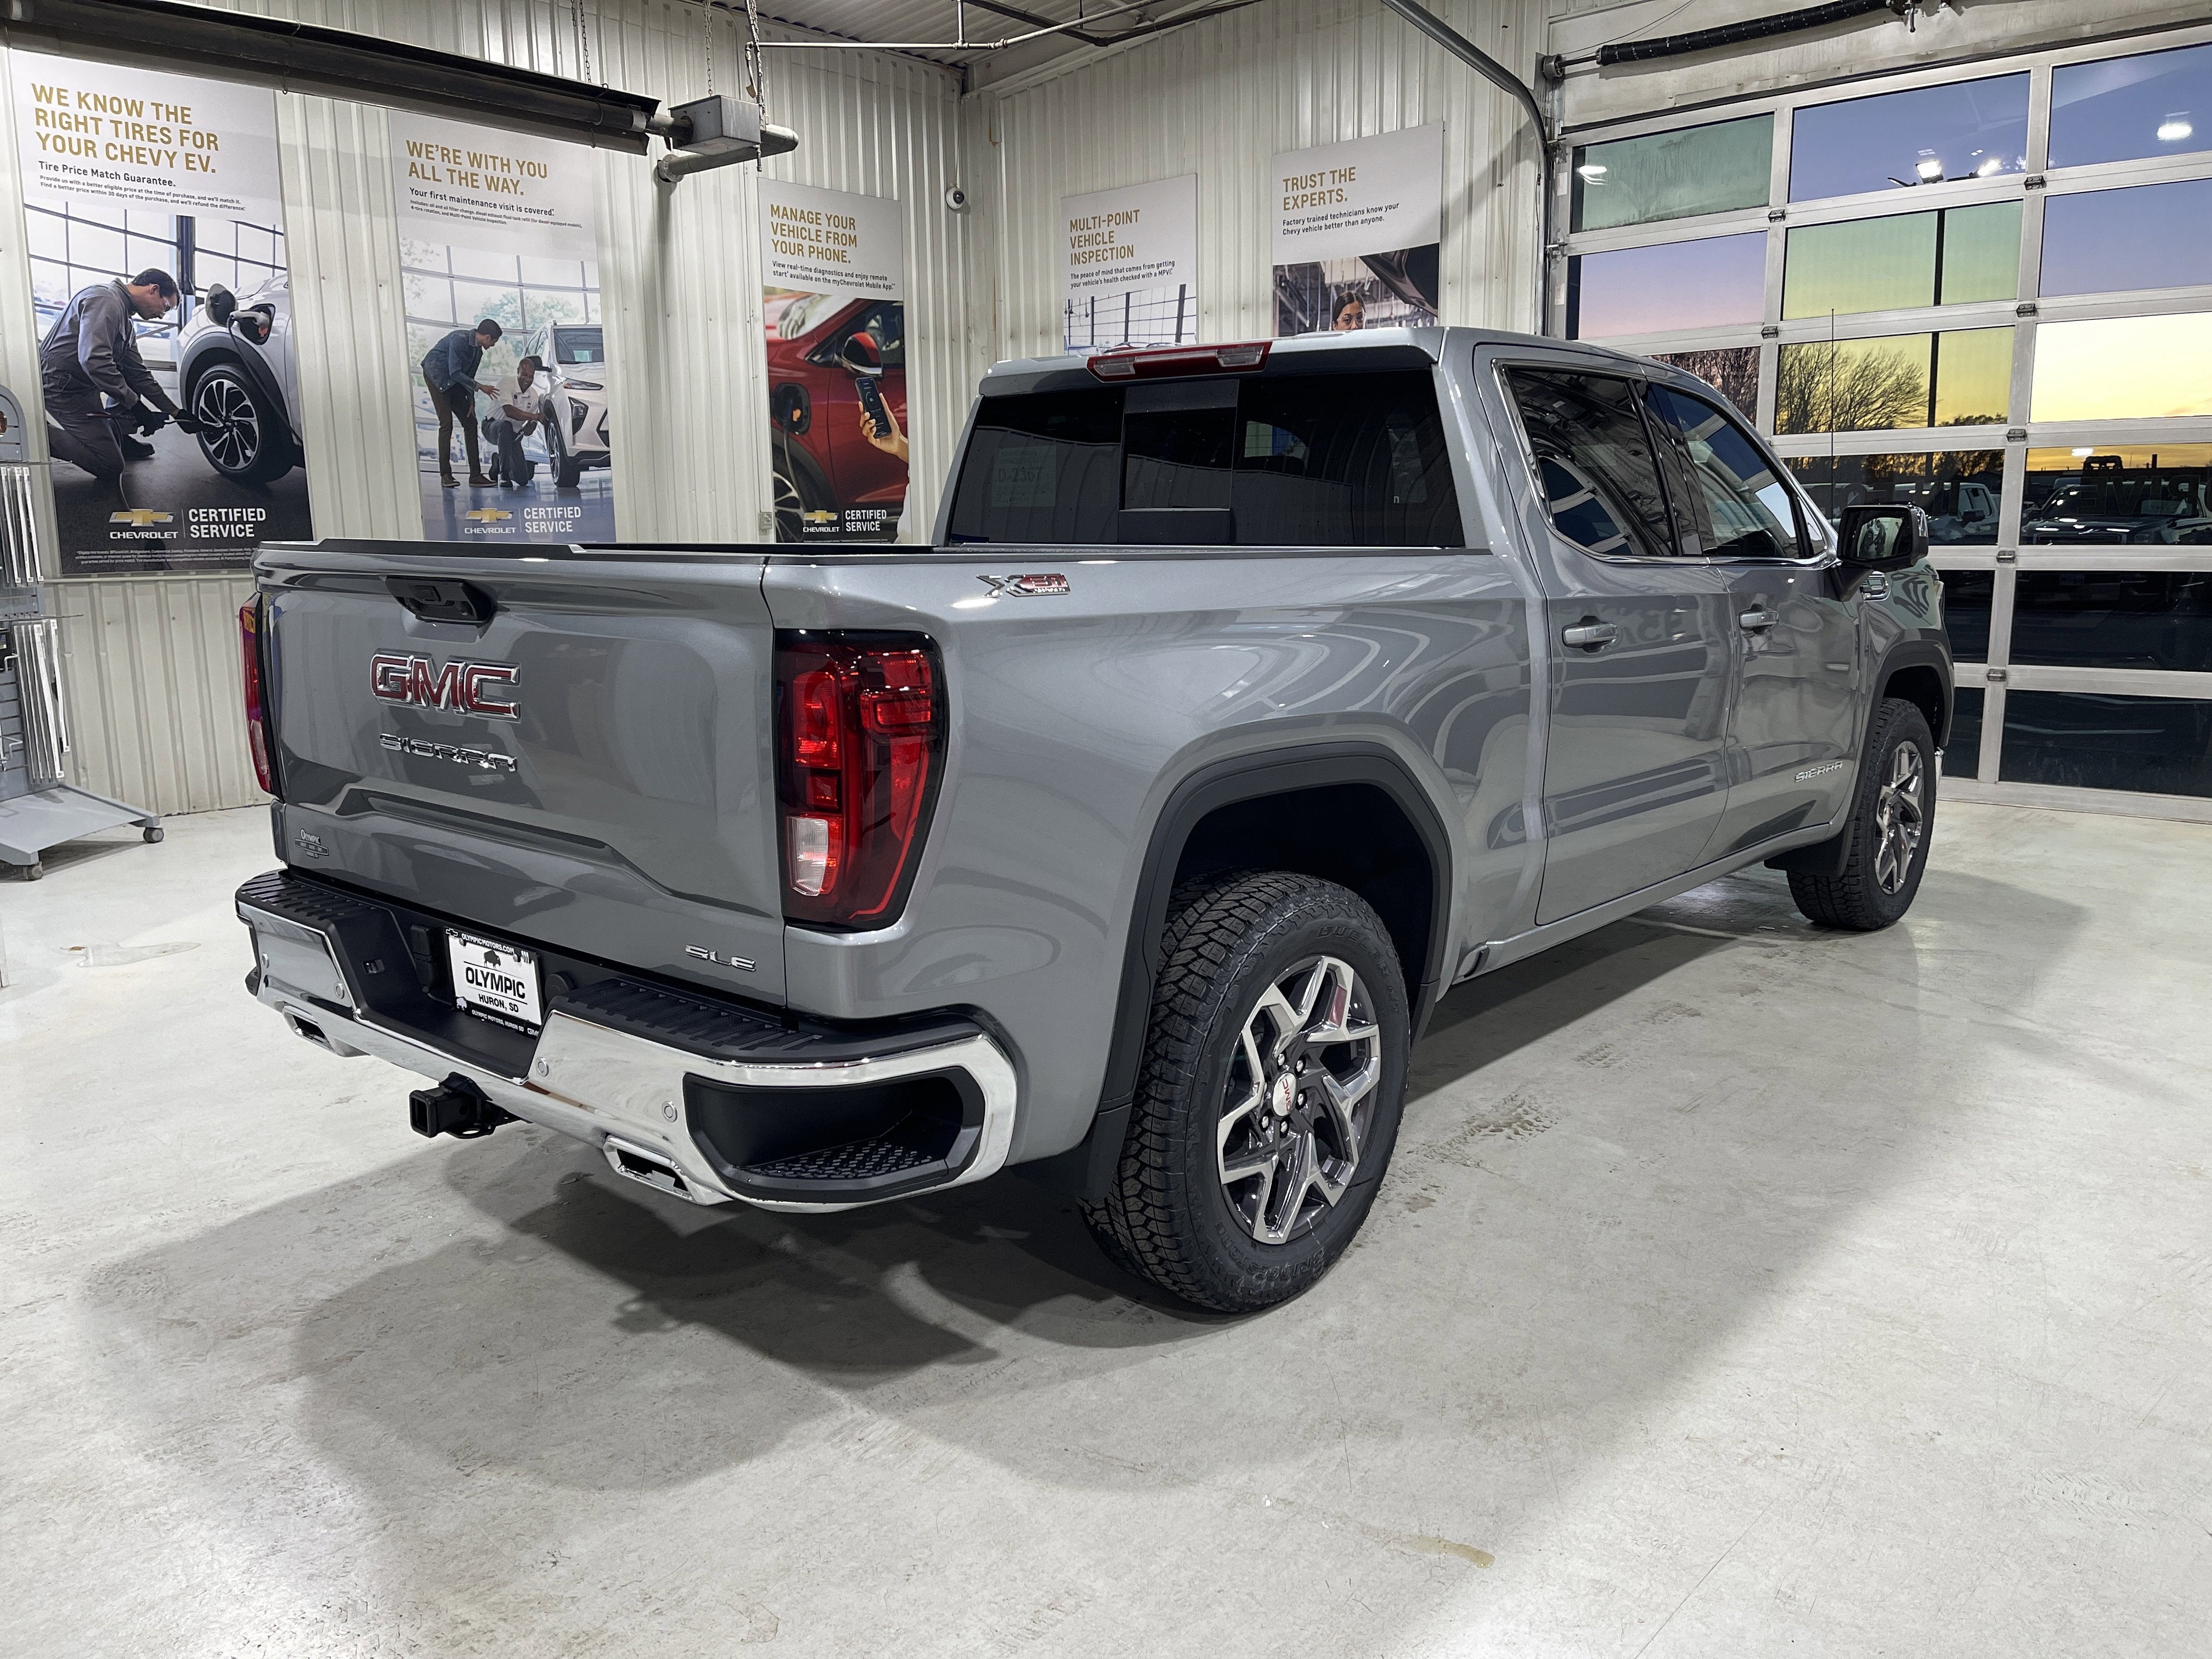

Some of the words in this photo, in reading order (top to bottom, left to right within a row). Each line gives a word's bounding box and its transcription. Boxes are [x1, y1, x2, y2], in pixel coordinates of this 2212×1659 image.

[32, 83, 69, 107] WE
[77, 92, 143, 117] KNOW
[151, 102, 192, 125] THE
[35, 108, 103, 135] RIGHT
[110, 120, 171, 144] TIRES
[179, 129, 218, 151] FOR
[36, 132, 97, 158] YOUR
[106, 143, 177, 168] CHEVY
[185, 153, 216, 173] EV.
[406, 140, 462, 166] WE'RE
[467, 151, 511, 174] WITH
[516, 159, 548, 179] YOU
[38, 161, 59, 171] Tire
[62, 164, 88, 176] Price
[91, 168, 121, 180] Match
[123, 173, 176, 187] Guarantee.
[408, 162, 442, 183] ALL
[446, 168, 479, 189] THE
[484, 174, 524, 196] WAY.
[1283, 172, 1326, 193] TRUST
[1329, 166, 1356, 185] THE
[409, 187, 427, 198] Your
[430, 190, 447, 201] first
[449, 195, 497, 209] maintenance
[499, 202, 515, 212] visit
[516, 204, 523, 212] is
[1283, 188, 1348, 211] EXPERTS.
[770, 204, 822, 226] MANAGE
[825, 213, 856, 231] YOUR
[1070, 209, 1140, 233] MULTI-POINT
[1283, 218, 1306, 227] Factory
[1307, 214, 1328, 223] trained
[1330, 209, 1365, 220] technicians
[1385, 203, 1400, 212] your
[770, 221, 822, 243] VEHICLE
[826, 230, 857, 248] FROM
[1283, 228, 1301, 238] Chevy
[1302, 224, 1323, 234] vehicle
[1324, 222, 1344, 230] better
[1361, 216, 1385, 225] anyone.
[1070, 230, 1115, 249] VEHICLE
[771, 239, 804, 257] YOUR
[808, 245, 851, 264] PHONE.
[1070, 244, 1134, 266] INSPECTION
[772, 261, 786, 269] View
[787, 263, 812, 273] real-time
[814, 267, 843, 277] diagnostics
[1071, 281, 1081, 290] your
[1082, 278, 1103, 287] vehicle's
[1103, 276, 1119, 284] health
[1120, 273, 1141, 282] checked
[1142, 271, 1153, 279] with
[1080, 272, 1094, 280] peace
[1101, 268, 1113, 276] mind
[1156, 260, 1175, 270] getting
[790, 272, 813, 282] available
[832, 278, 865, 288] myChevrolet
[865, 281, 882, 290] Mobile
[188, 508, 267, 522] CERTIFIED
[523, 506, 582, 520] CERTIFIED
[845, 509, 887, 520] CERTIFIED
[110, 531, 179, 539] CHEVROLET
[190, 524, 255, 539] SERVICE
[524, 520, 573, 533] SERVICE
[845, 521, 881, 532] SERVICE
[370, 652, 520, 722] GMC
[379, 733, 518, 772] SIERRA
[1795, 760, 1843, 782] SIERRA
[461, 933, 515, 954] OLYMPICMOTORS.COM
[685, 944, 756, 972] SLE
[466, 967, 526, 1000] OLYMPIC
[478, 993, 507, 1012] HURON,
[509, 1002, 519, 1013] SD
[1282, 1078, 1291, 1113] GMC
